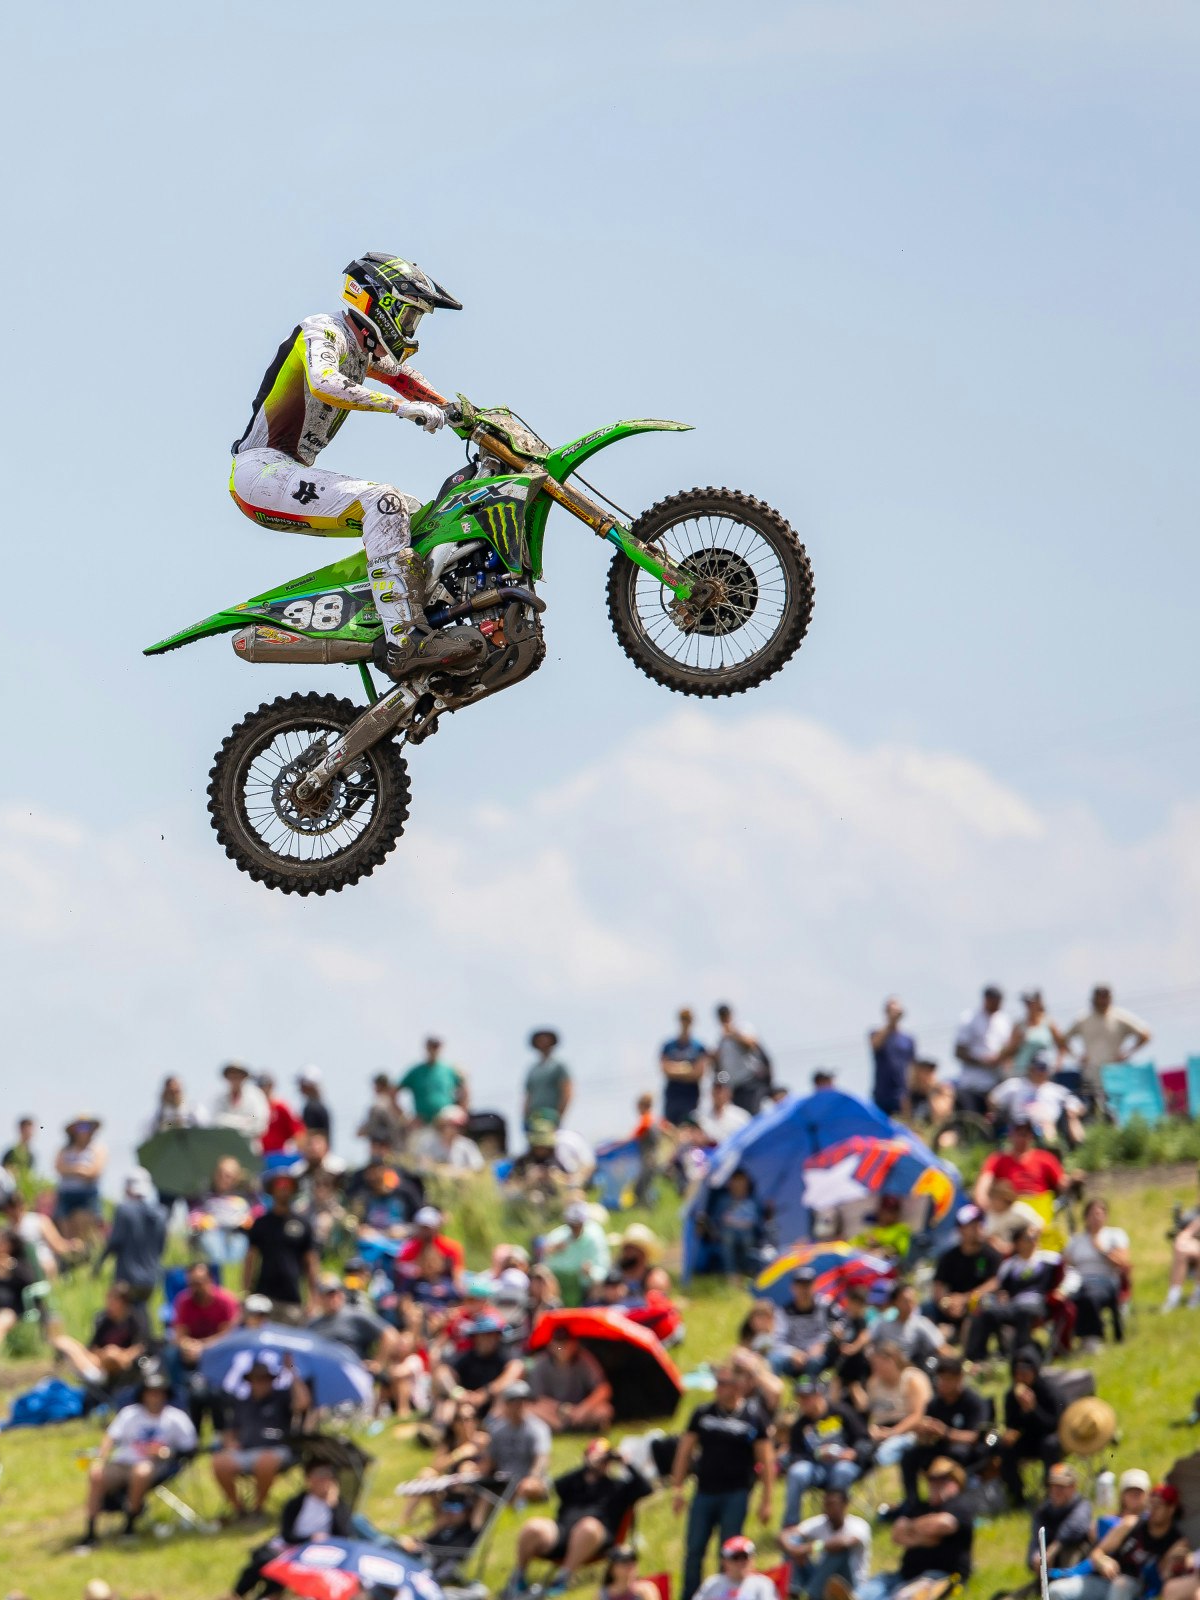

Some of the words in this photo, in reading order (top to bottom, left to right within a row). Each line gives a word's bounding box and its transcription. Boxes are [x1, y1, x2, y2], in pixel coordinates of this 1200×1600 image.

[349, 281, 360, 292] BELL
[375, 307, 398, 339] MONSTER
[561, 440, 583, 459] PRO
[560, 496, 591, 521] SHOWA
[266, 516, 310, 527] MONSTER
[285, 575, 316, 592] Kawasaki
[373, 581, 395, 591] FOX
